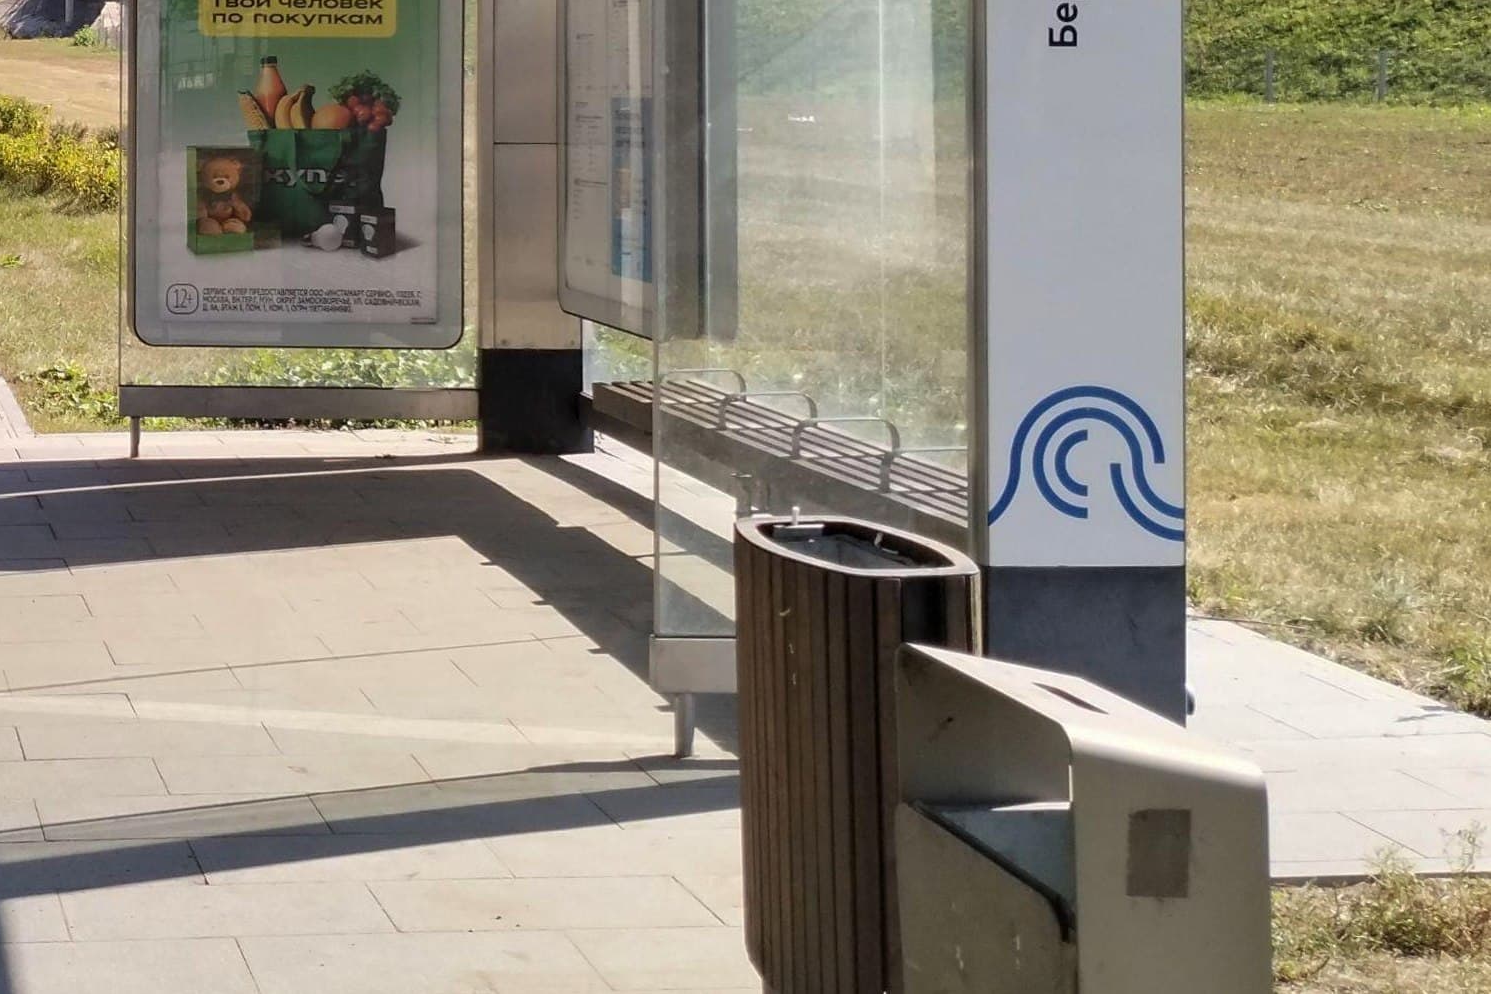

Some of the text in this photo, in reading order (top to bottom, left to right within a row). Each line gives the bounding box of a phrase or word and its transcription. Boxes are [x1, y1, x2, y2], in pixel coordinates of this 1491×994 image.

[211, 12, 384, 26] по покупкам
[173, 288, 195, 309] 12+
